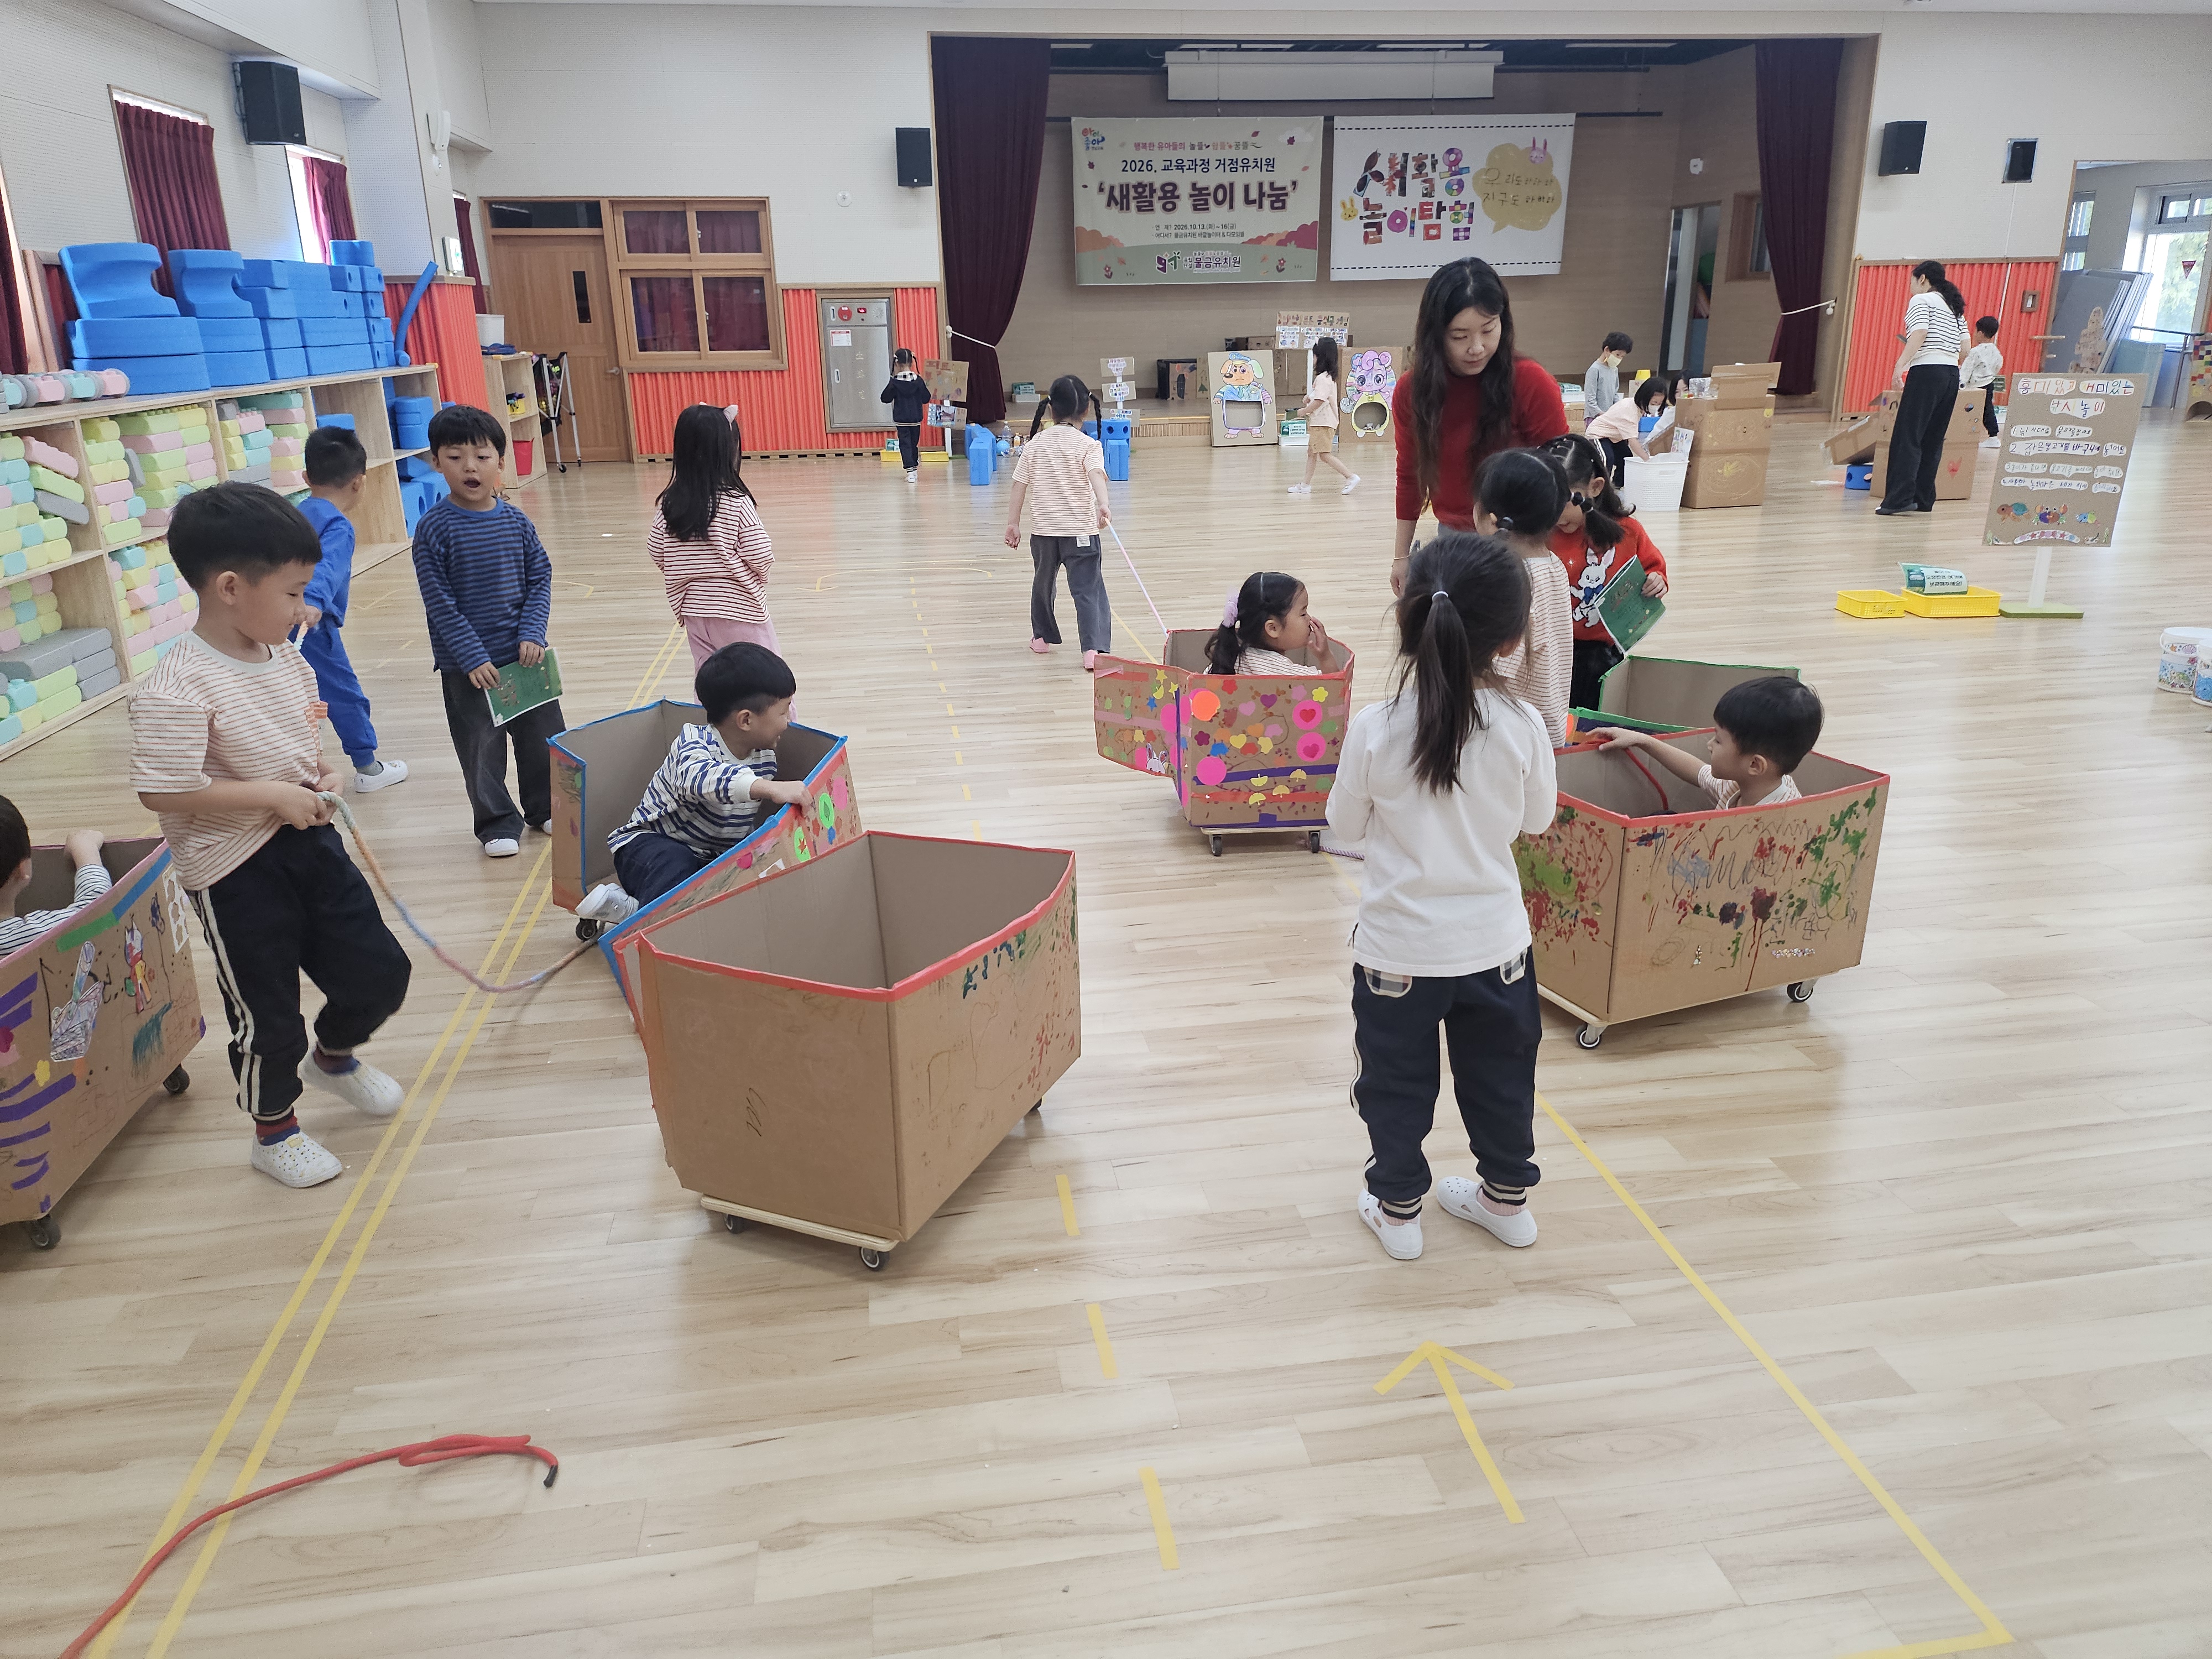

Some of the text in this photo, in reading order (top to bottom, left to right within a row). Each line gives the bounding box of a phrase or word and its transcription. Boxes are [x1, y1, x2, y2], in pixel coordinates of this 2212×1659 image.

[1082, 127, 1100, 137] 아이
[1134, 142, 1154, 151] 행복한
[1157, 142, 1185, 151] 유아들의
[1121, 158, 1275, 173] 2026. 교육과정 거점유치원
[1353, 148, 1470, 198] 새활용
[1189, 182, 1234, 212] 놀이
[1483, 192, 1519, 206] 지구도
[1194, 256, 1241, 269] 물금유치원
[2020, 378, 2076, 394] 흥미있고
